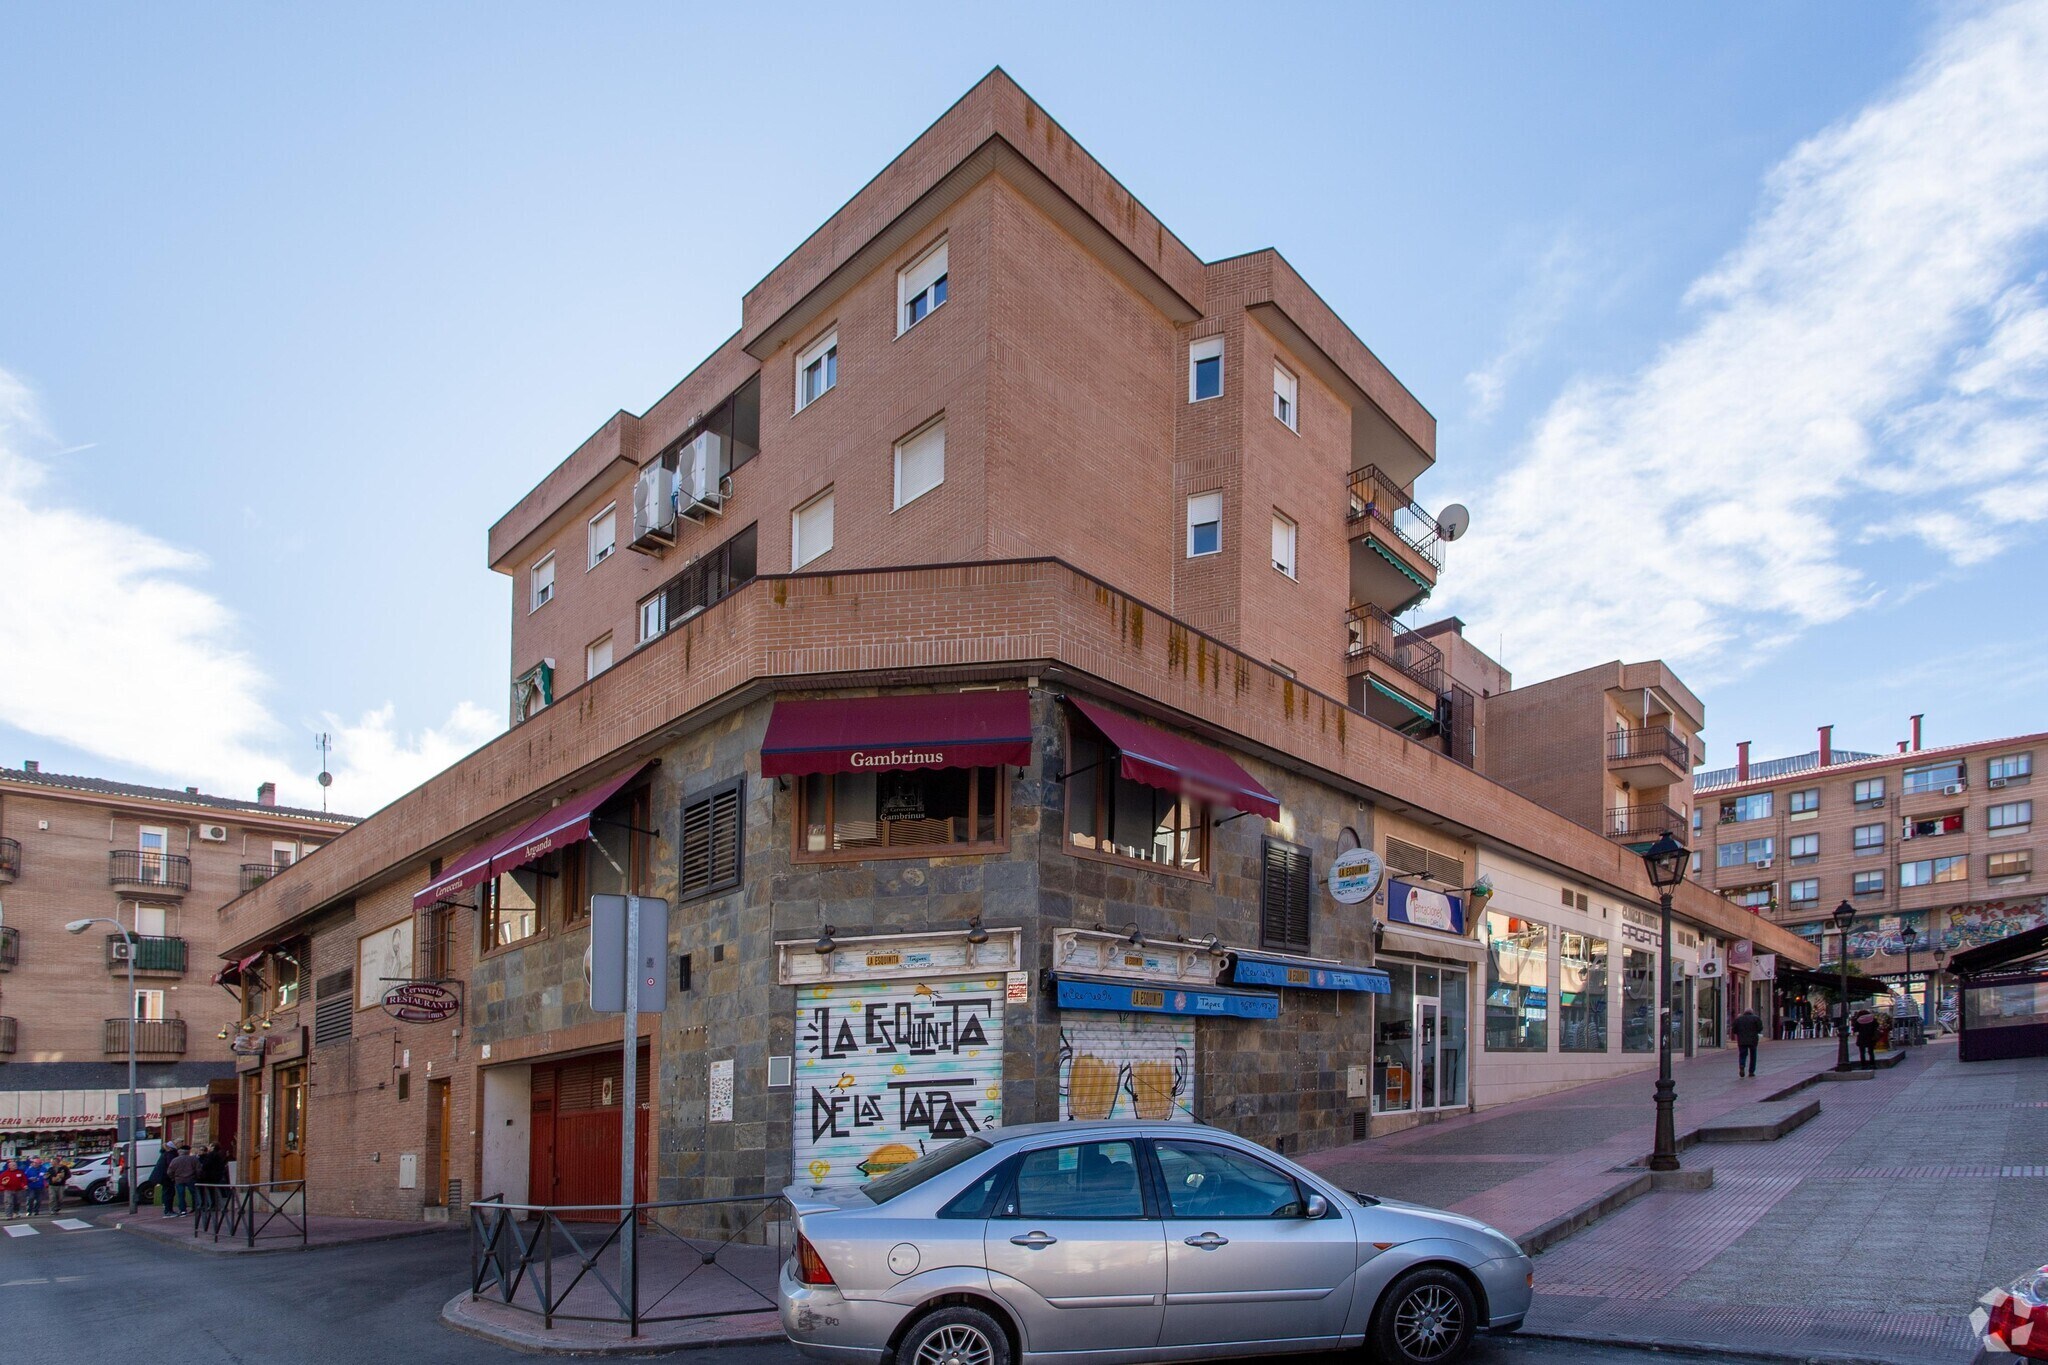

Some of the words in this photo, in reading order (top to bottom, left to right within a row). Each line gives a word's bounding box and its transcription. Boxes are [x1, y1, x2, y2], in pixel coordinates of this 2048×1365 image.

[850, 750, 943, 767] Gambrinus
[880, 812, 925, 821] Gambrinus
[525, 837, 552, 858] Arganda
[867, 956, 873, 966] LA
[875, 955, 899, 965] ESQUINITA
[403, 987, 443, 996] Cervecería
[1133, 990, 1139, 1004] LA
[1140, 991, 1163, 1006] ESQUINITA
[389, 996, 455, 1009] RESTAURANTE
[814, 1007, 858, 1059] LA
[865, 998, 992, 1055] ESQUINITA
[812, 1086, 850, 1144] DE
[854, 1095, 884, 1127] LAS
[887, 1078, 980, 1139] TAPAS
[34, 1116, 66, 1124] FRUTOS
[68, 1115, 94, 1123] SECOS
